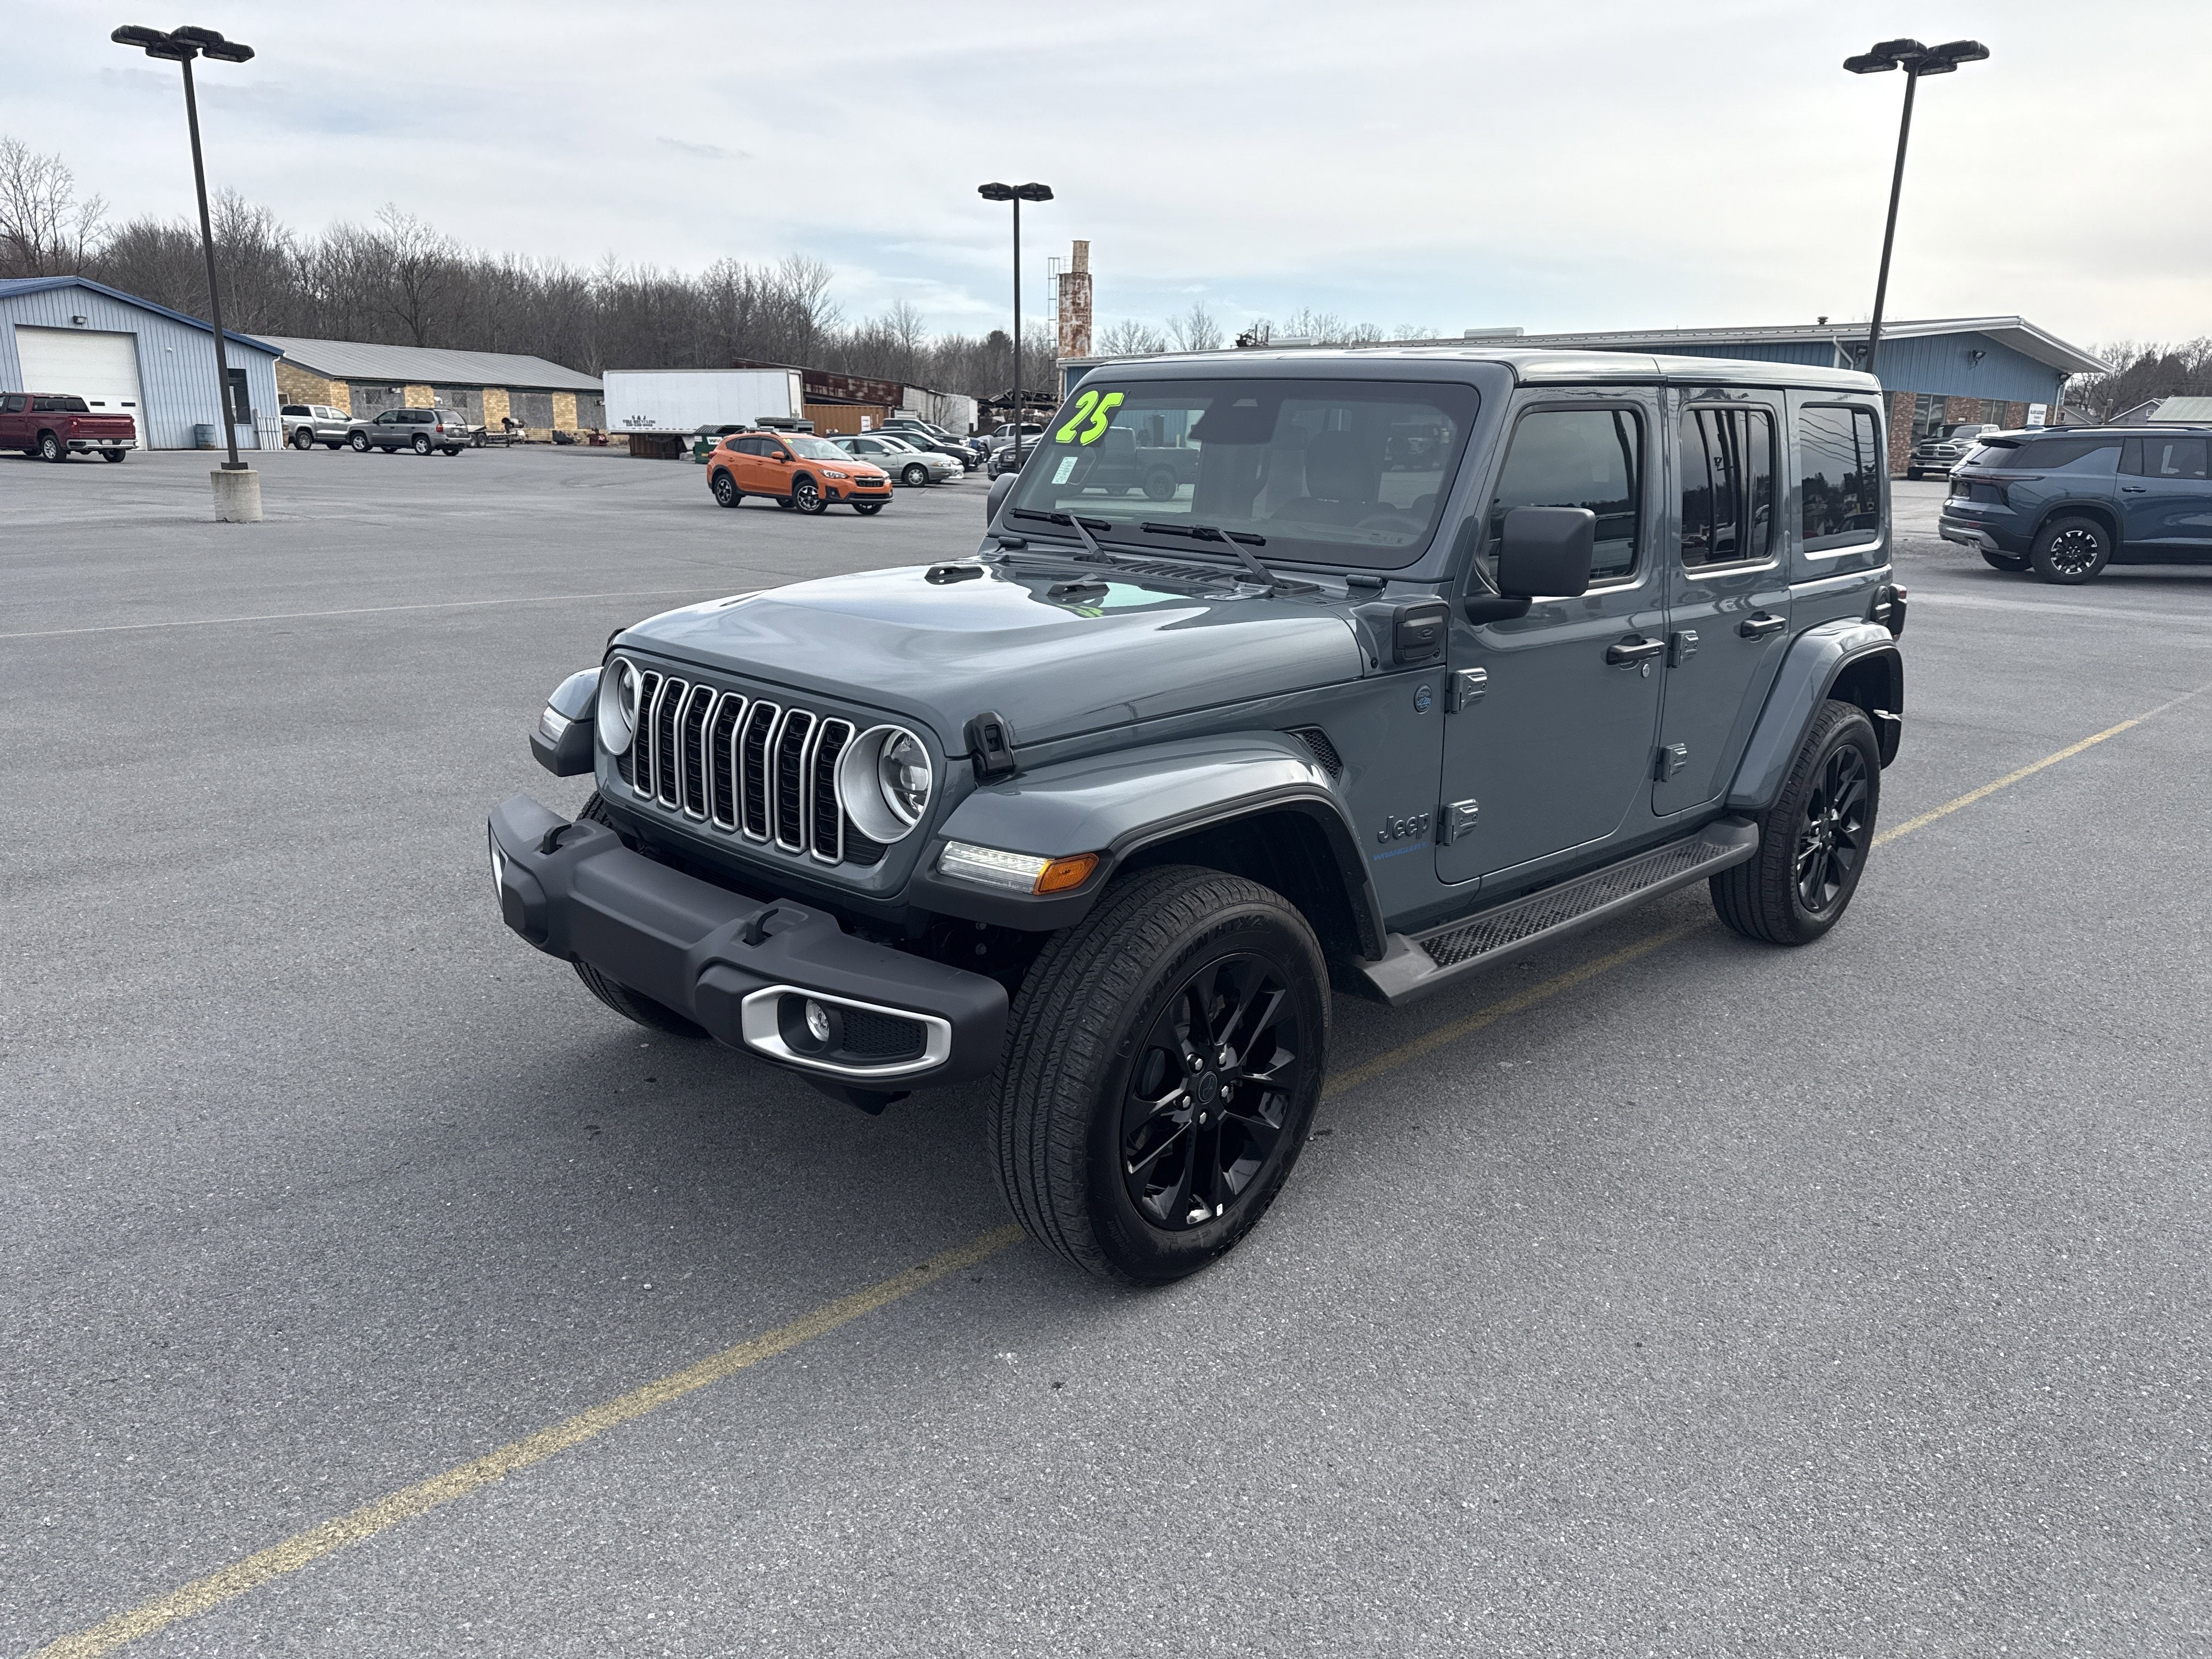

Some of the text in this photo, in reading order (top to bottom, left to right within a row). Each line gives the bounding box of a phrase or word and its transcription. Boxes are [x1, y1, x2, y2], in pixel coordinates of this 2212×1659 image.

[1056, 390, 1124, 446] 25
[1378, 813, 1431, 844] Jeep
[1373, 843, 1421, 861] WRANGLER
